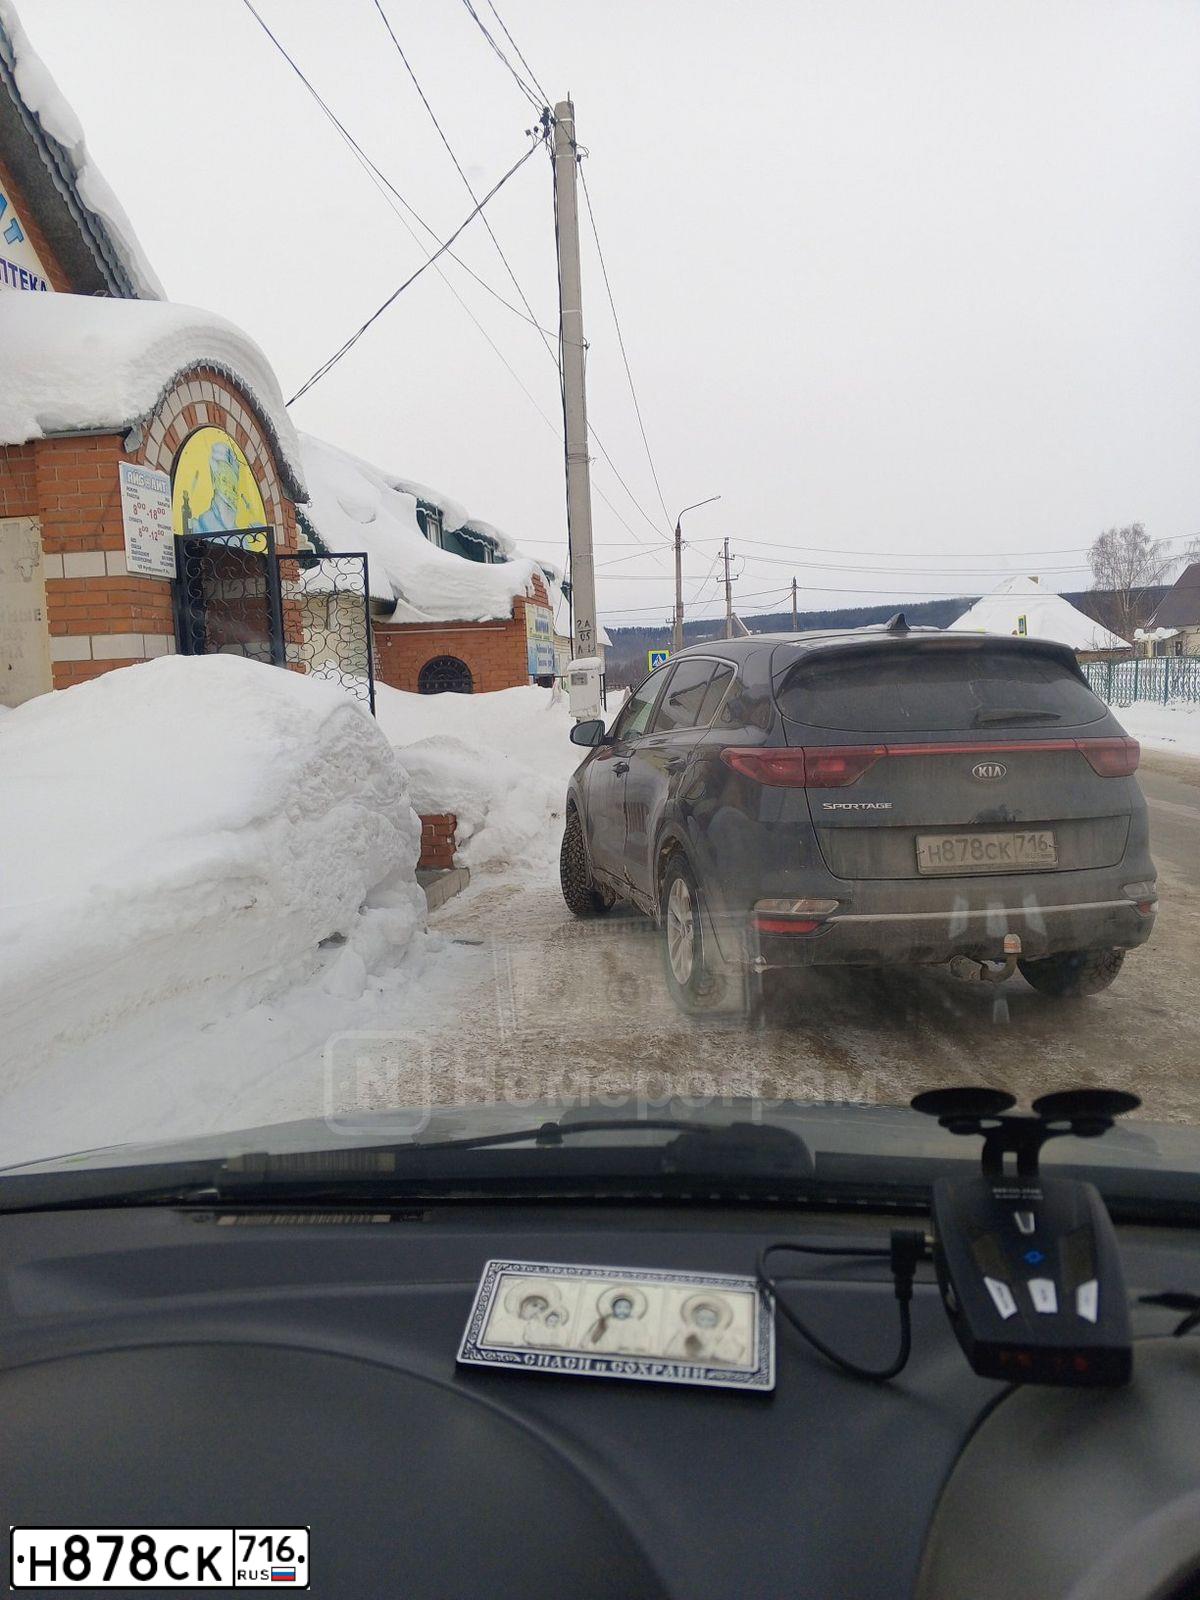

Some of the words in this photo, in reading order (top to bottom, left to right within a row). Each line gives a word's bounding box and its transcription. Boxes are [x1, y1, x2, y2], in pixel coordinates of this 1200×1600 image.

[978, 766, 1002, 777] KIA
[822, 802, 893, 810] SPORTAGE
[1015, 834, 1049, 851] 716
